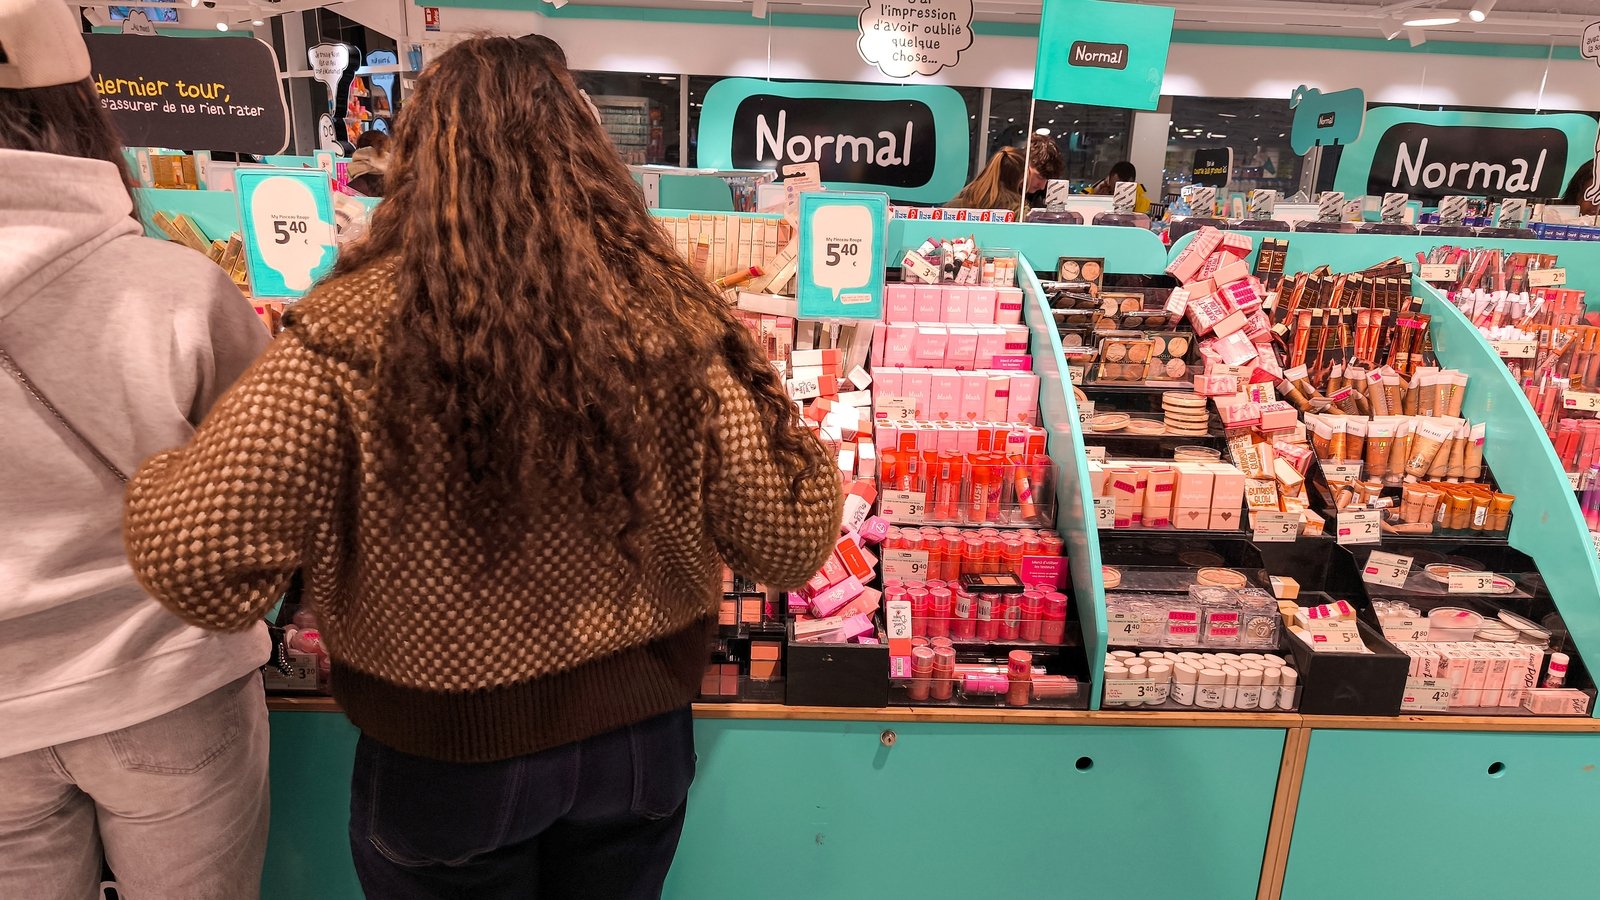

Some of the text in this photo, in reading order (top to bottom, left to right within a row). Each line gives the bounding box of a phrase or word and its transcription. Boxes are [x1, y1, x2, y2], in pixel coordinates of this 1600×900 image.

[881, 4, 956, 20] l'impression
[873, 19, 961, 36] d'avoir oublié
[891, 36, 940, 50] quelque
[1075, 45, 1123, 65] Normal
[176, 80, 230, 103] tour,
[101, 98, 265, 117] s'assurer de ne rien rater
[756, 110, 913, 167] Normal
[1391, 137, 1547, 193] Normal
[973, 483, 983, 511] BLUSH
